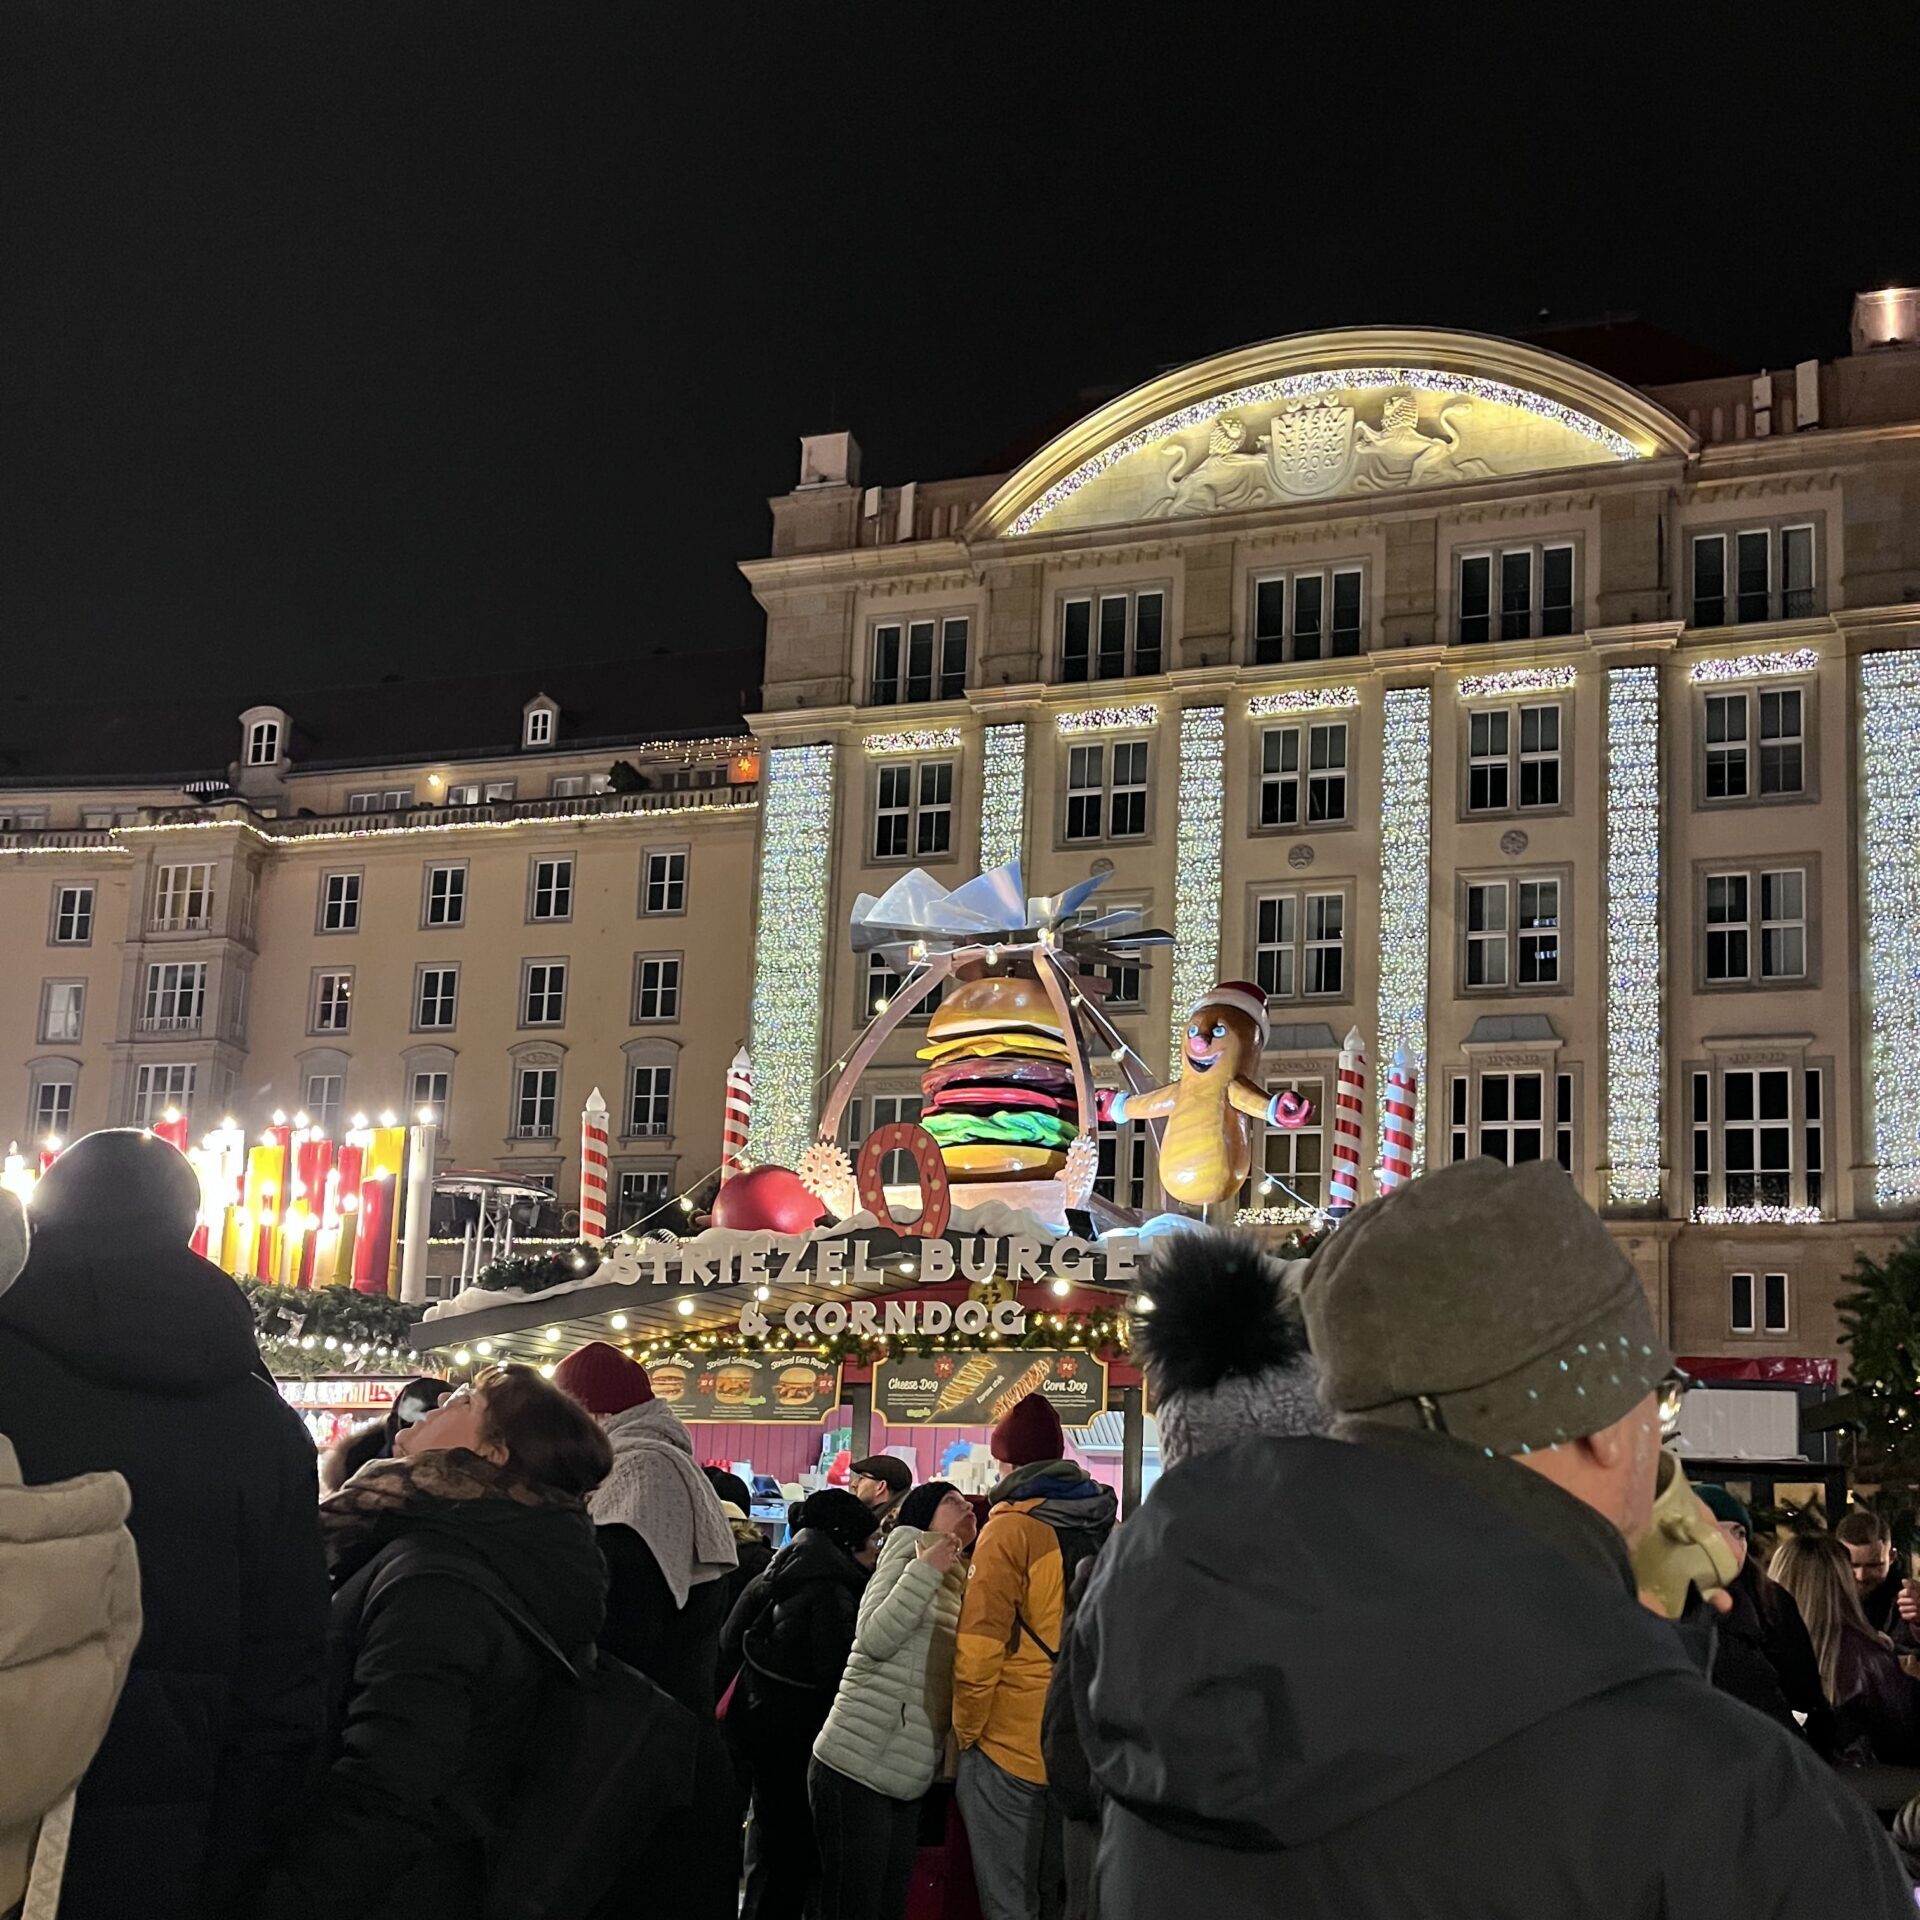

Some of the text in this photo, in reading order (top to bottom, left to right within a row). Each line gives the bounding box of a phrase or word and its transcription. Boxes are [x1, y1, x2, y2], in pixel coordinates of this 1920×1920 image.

[611, 1235, 1170, 1287] STRIEZEL BURGE
[738, 1300, 1027, 1337] & CORNDOG
[888, 1377, 939, 1392] Cheese Dog
[1043, 1379, 1088, 1394] Corn Dog
